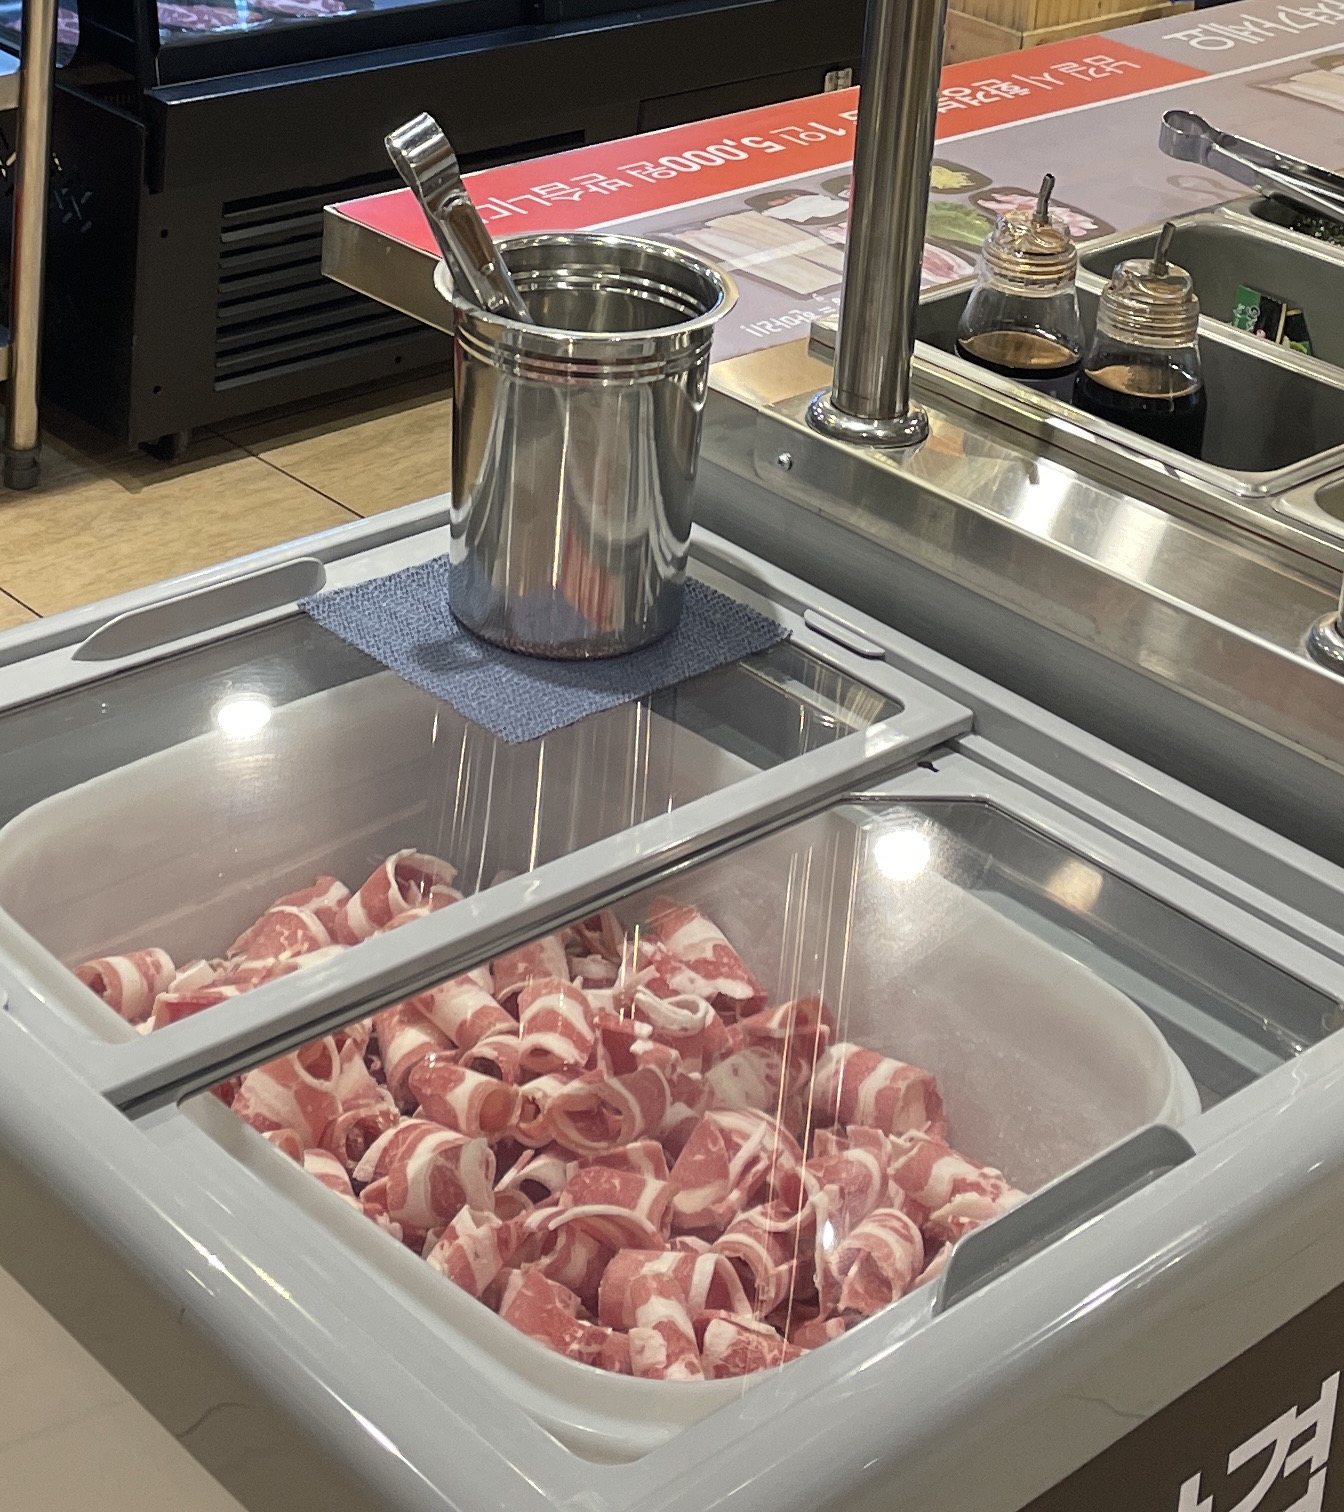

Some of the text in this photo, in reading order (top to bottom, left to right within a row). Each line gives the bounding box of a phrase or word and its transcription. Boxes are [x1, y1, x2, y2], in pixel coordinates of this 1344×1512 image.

[1049, 54, 1142, 81] 남길
[1011, 73, 1064, 90] 시
[769, 121, 848, 146] 1인
[617, 136, 787, 183] 5,000원
